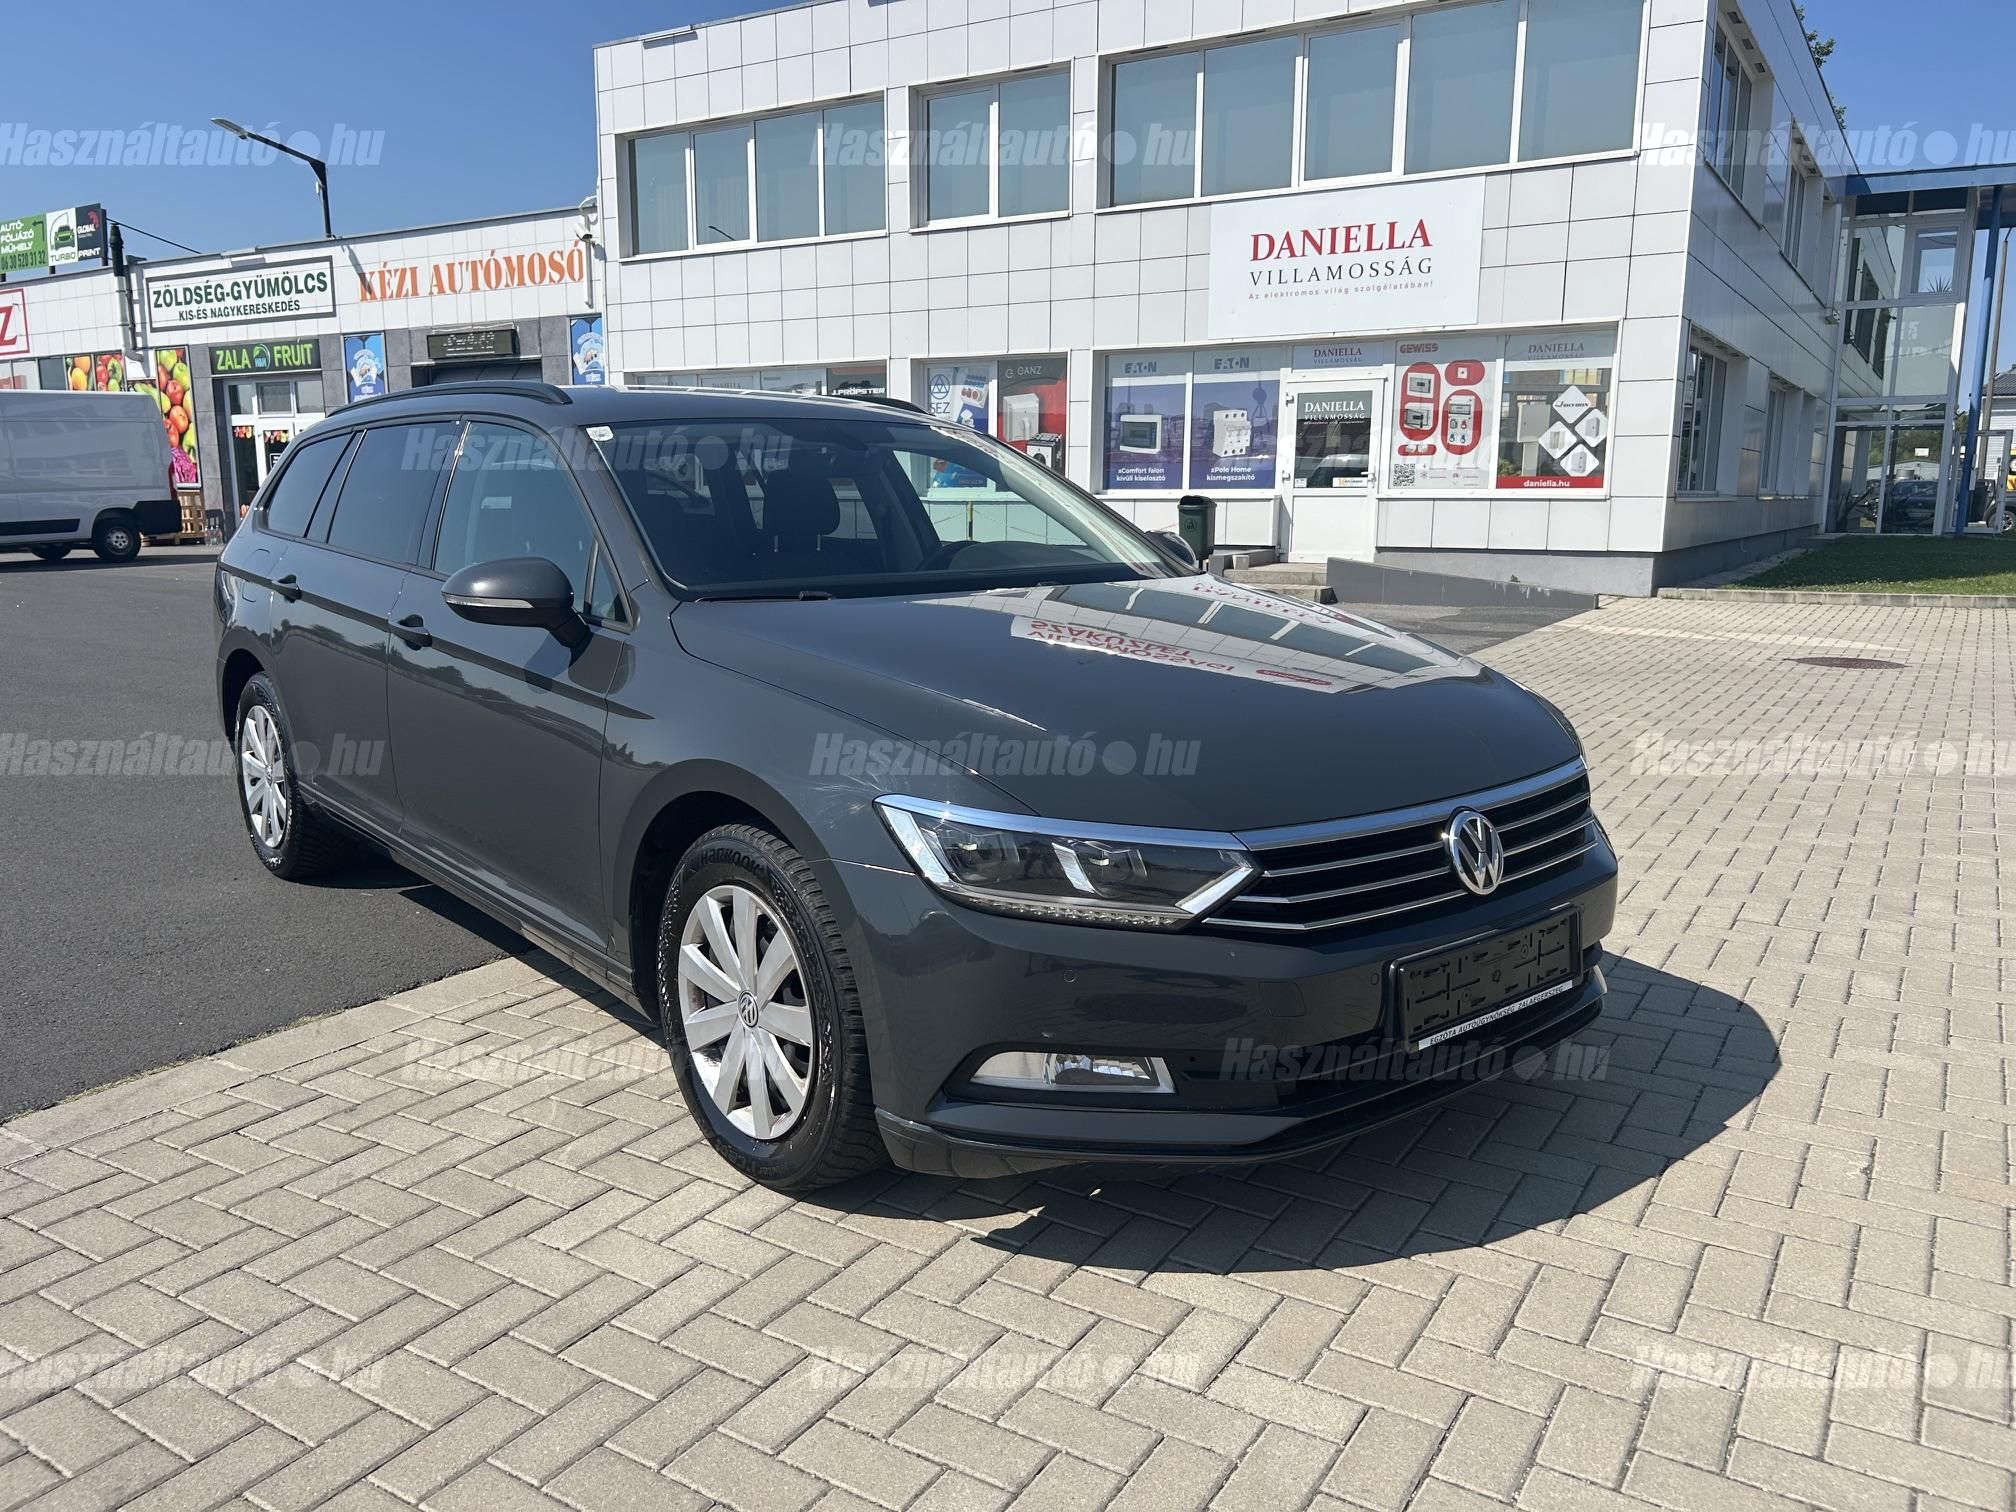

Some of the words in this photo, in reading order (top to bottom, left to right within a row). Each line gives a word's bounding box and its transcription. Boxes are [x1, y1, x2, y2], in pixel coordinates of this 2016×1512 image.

[1250, 218, 1432, 261] DANIELLA
[50, 251, 76, 262] TURBO
[78, 247, 101, 258] PRINT
[358, 261, 420, 302] KÉZI
[429, 240, 585, 296] AUTÓMOSÓ
[1250, 256, 1432, 286] VILLAMOSSÁG
[152, 271, 328, 309] ZÖLDSÉG-GYÜMÖLCS
[1248, 292, 1260, 300] Az
[1264, 288, 1320, 299] elektromos
[1324, 284, 1349, 295] világ
[1354, 281, 1434, 293] szolgálatában!
[210, 297, 301, 319] NAGYKERESKEDÉS
[1314, 347, 1362, 358] DANIELLA
[1528, 342, 1584, 353] DANIELLA
[216, 348, 252, 371] ZALA
[273, 343, 313, 367] FRUIT
[1017, 366, 1042, 376] GANZ
[930, 401, 950, 415] SEZ
[1304, 400, 1365, 413] DANIELLA
[1304, 412, 1365, 421] VILLAMOSSÁG
[1231, 465, 1252, 473] Home
[1523, 479, 1570, 488] daniella.hu
